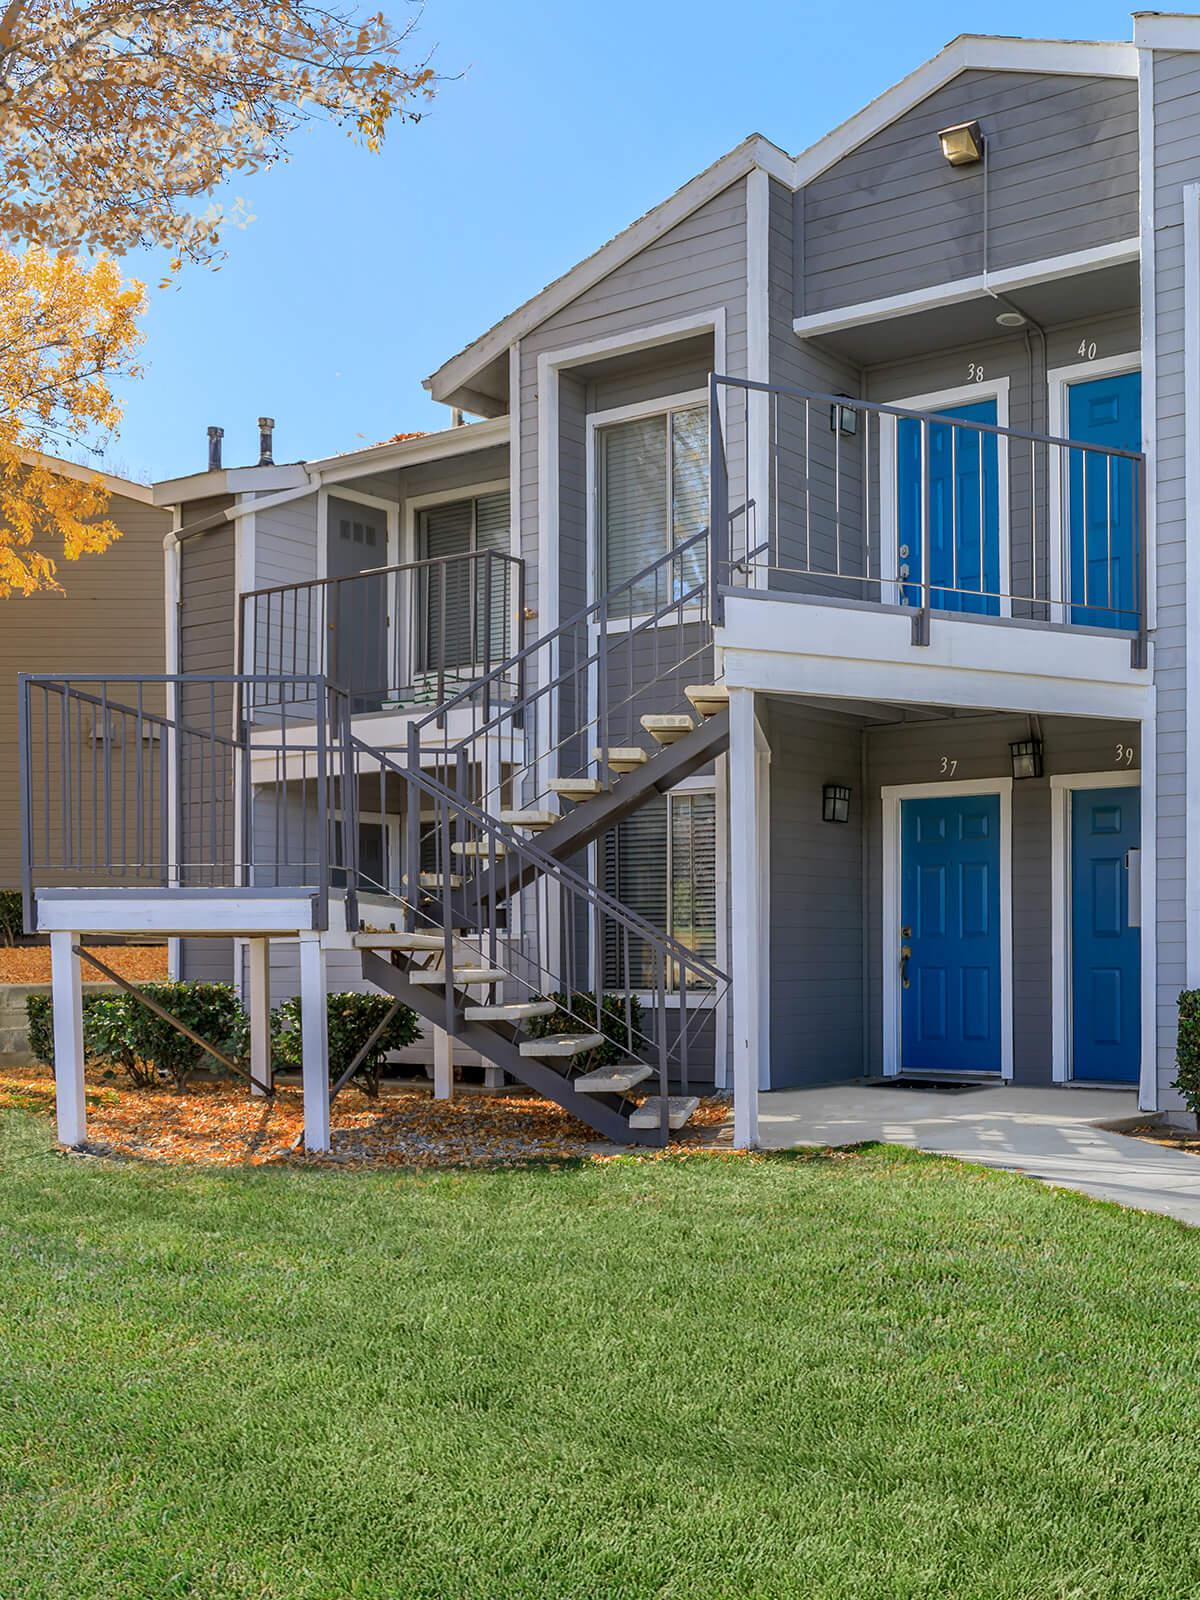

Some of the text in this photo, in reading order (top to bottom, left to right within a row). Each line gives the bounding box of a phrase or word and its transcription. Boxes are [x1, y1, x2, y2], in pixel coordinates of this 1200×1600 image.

[1077, 339, 1097, 360] 40
[967, 363, 984, 382] 38
[1115, 743, 1133, 766] 39
[940, 756, 957, 777] 37
